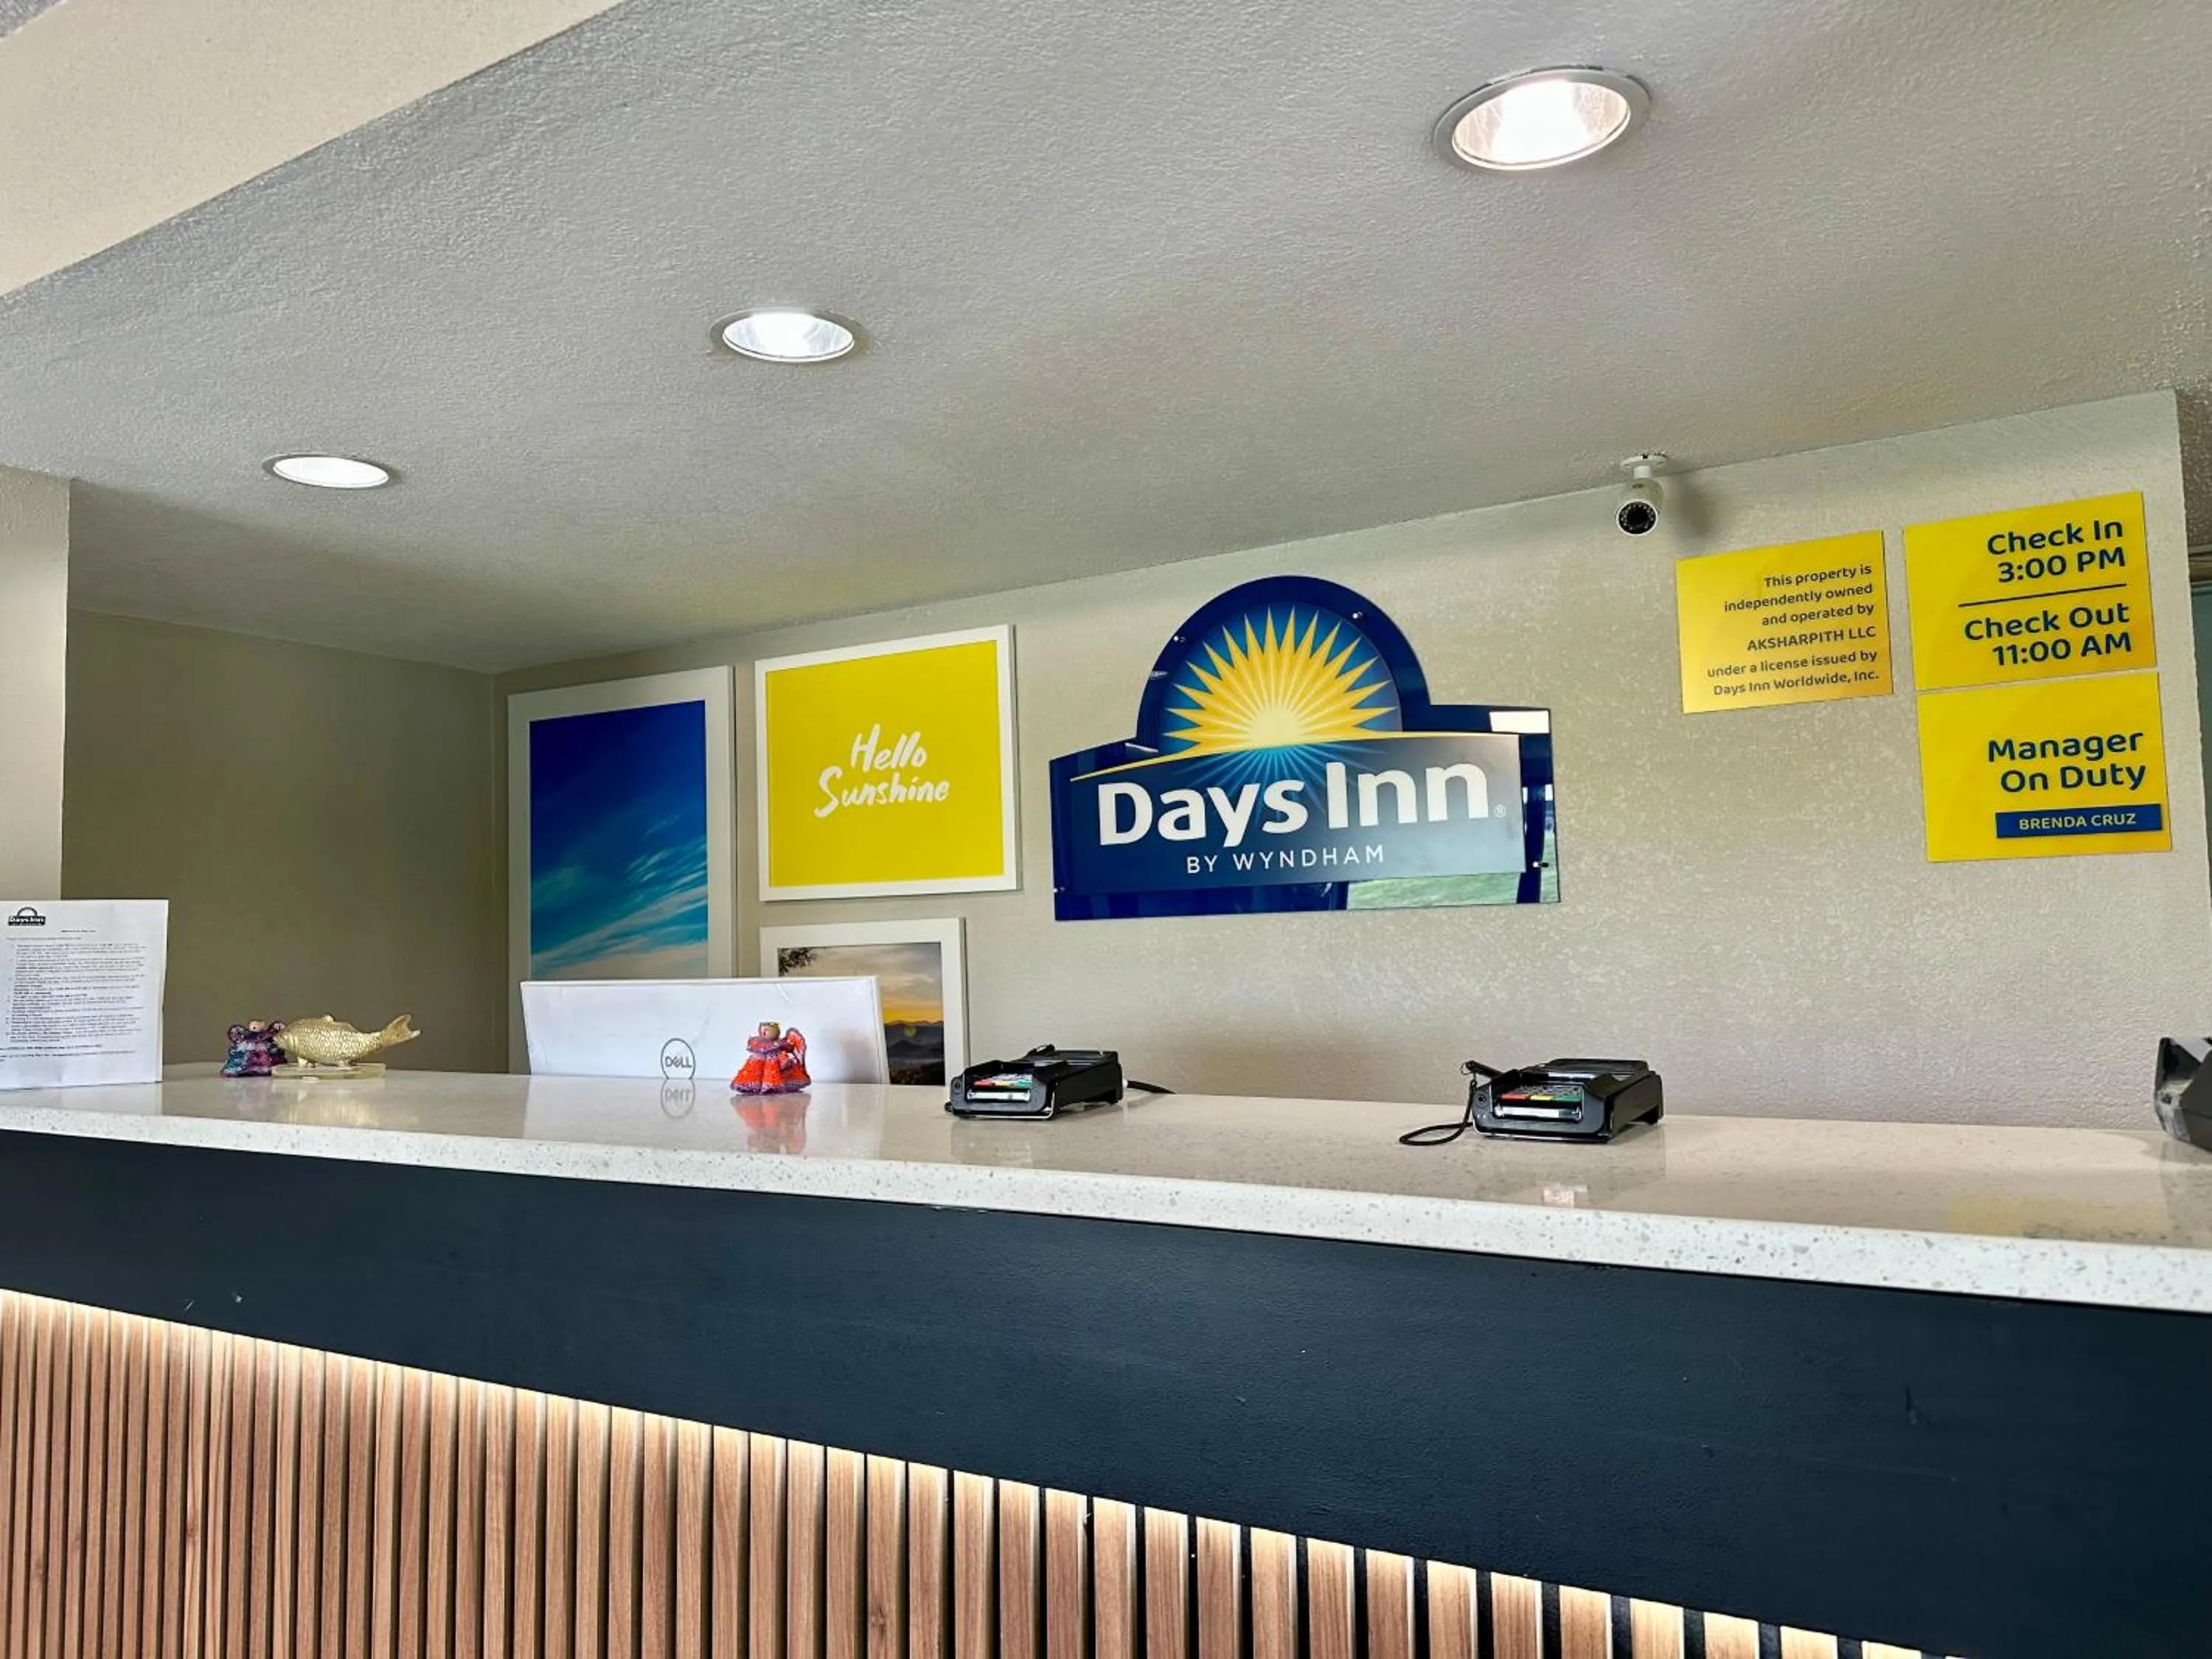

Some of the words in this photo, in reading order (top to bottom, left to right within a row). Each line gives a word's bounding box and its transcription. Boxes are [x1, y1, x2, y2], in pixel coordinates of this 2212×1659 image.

[1987, 522, 2084, 555] Check
[2094, 520, 2124, 540] In
[1764, 577, 1792, 588] This
[1795, 567, 1857, 585] property
[1860, 564, 1872, 574] is
[1997, 554, 2067, 583] 3:00
[2077, 546, 2126, 572] PM
[1725, 591, 1822, 612] independently
[1826, 584, 1873, 599] owned
[1762, 613, 1787, 626] and
[1790, 605, 1853, 624] operated
[1857, 603, 1874, 616] by
[1964, 610, 2061, 641] Check
[2069, 602, 2130, 628] Out
[1747, 629, 1844, 651] AKSHARPITH
[1848, 626, 1877, 639] LLC
[1992, 639, 2071, 666] 11:00
[2080, 631, 2132, 657] AM
[1708, 664, 1746, 678] under
[1750, 664, 1757, 673] a
[1761, 657, 1808, 672] license
[1812, 651, 1857, 666] issued
[1860, 650, 1877, 663] by
[1714, 683, 1746, 697] Days
[1750, 680, 1770, 692] Inn
[1773, 673, 1851, 690] Worldwide,
[1854, 669, 1879, 681] Inc.
[850, 723, 928, 773] Hello
[1988, 731, 2143, 762] Manager
[814, 765, 950, 818] Sunshine
[2000, 770, 2048, 793] On
[2059, 763, 2146, 790] Duty
[1098, 779, 1309, 848] Days
[1325, 761, 1489, 830] Inn
[2019, 815, 2087, 830] BRENDA
[2090, 813, 2136, 826] CRUZ
[1186, 855, 1217, 874] BY
[1232, 844, 1385, 872] WYNDHAM
[664, 1056, 692, 1068] DELL
